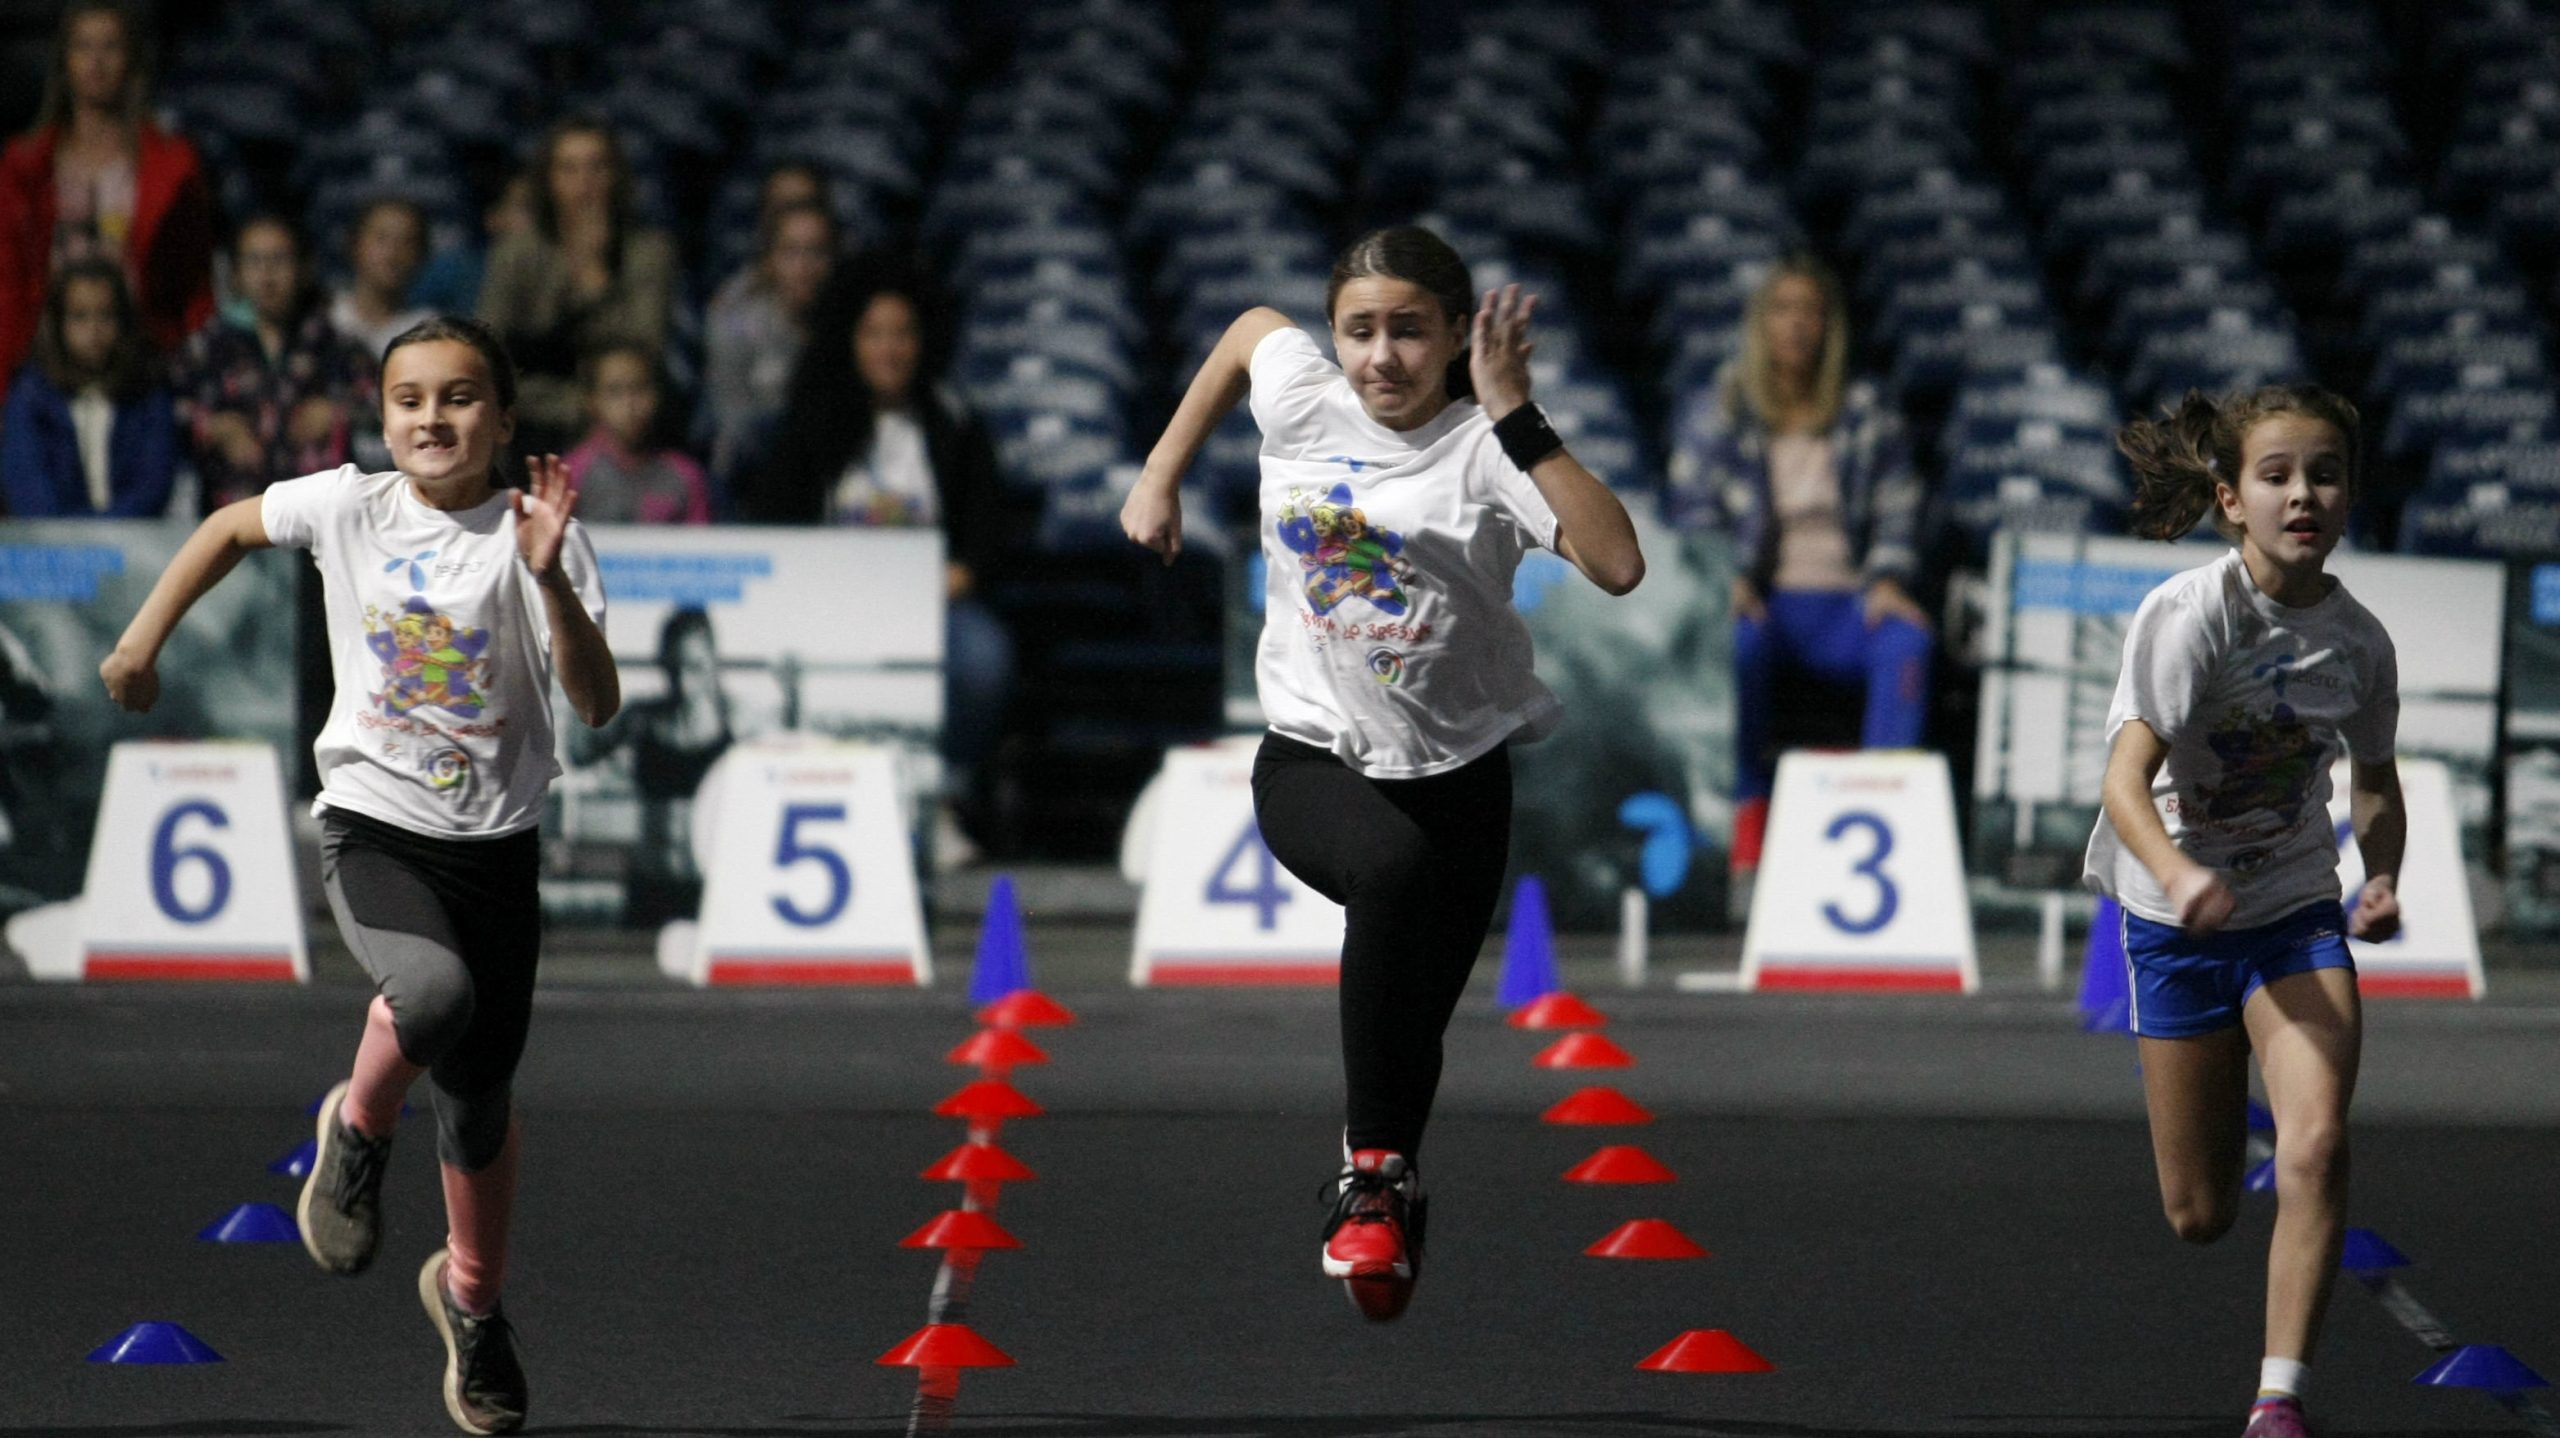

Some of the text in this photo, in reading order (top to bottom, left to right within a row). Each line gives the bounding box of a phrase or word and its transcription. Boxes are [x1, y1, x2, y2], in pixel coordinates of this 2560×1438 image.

[1365, 621, 1432, 645] ЗВЕЗД
[151, 801, 231, 925] 6
[772, 804, 852, 928] 5
[1206, 810, 1291, 929] 4
[1823, 811, 1899, 936] 3
